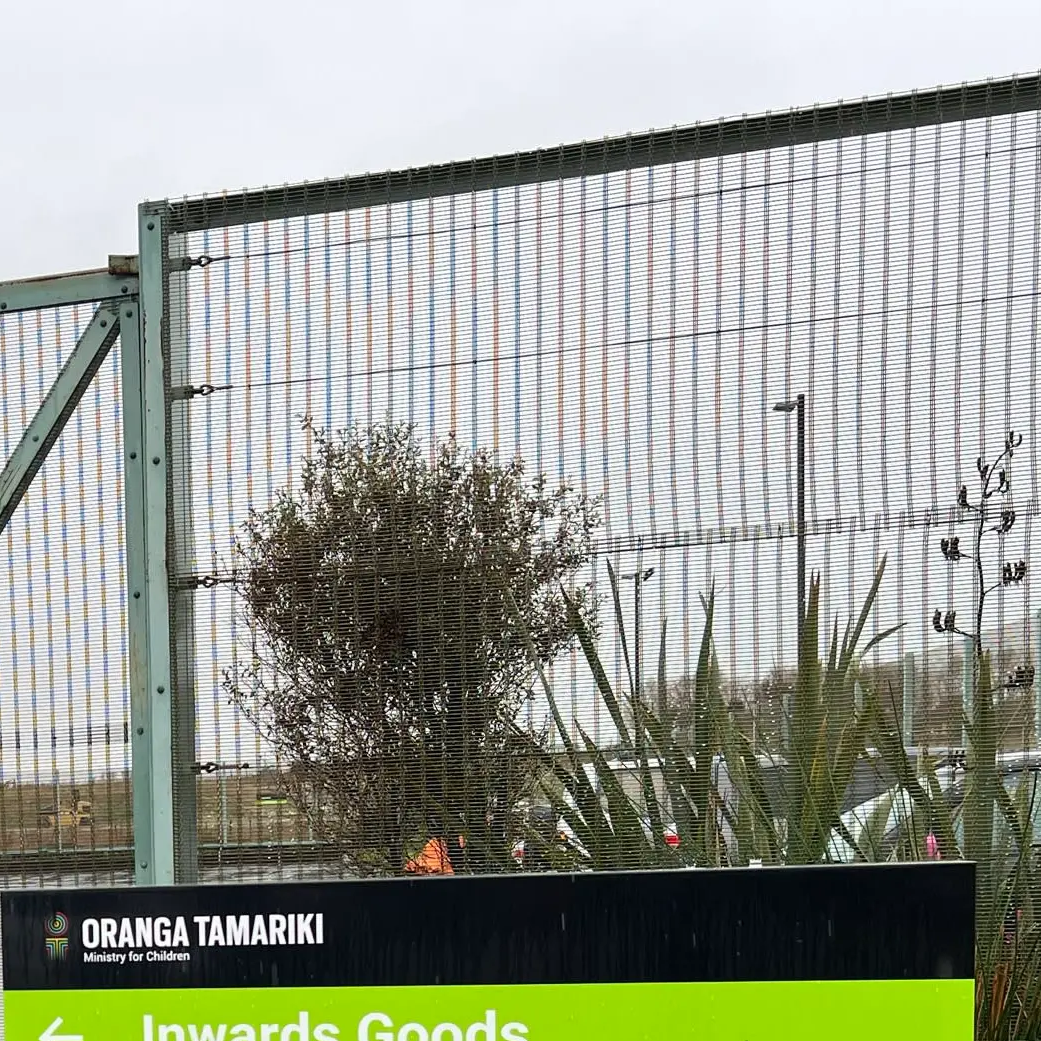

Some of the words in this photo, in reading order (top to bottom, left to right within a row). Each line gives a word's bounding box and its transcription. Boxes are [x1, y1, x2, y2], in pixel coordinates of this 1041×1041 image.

[82, 916, 190, 949] ORANGA
[194, 913, 324, 946] TAMARIKI
[83, 951, 126, 965] Ministry
[128, 950, 144, 962] for
[146, 949, 191, 962] Children
